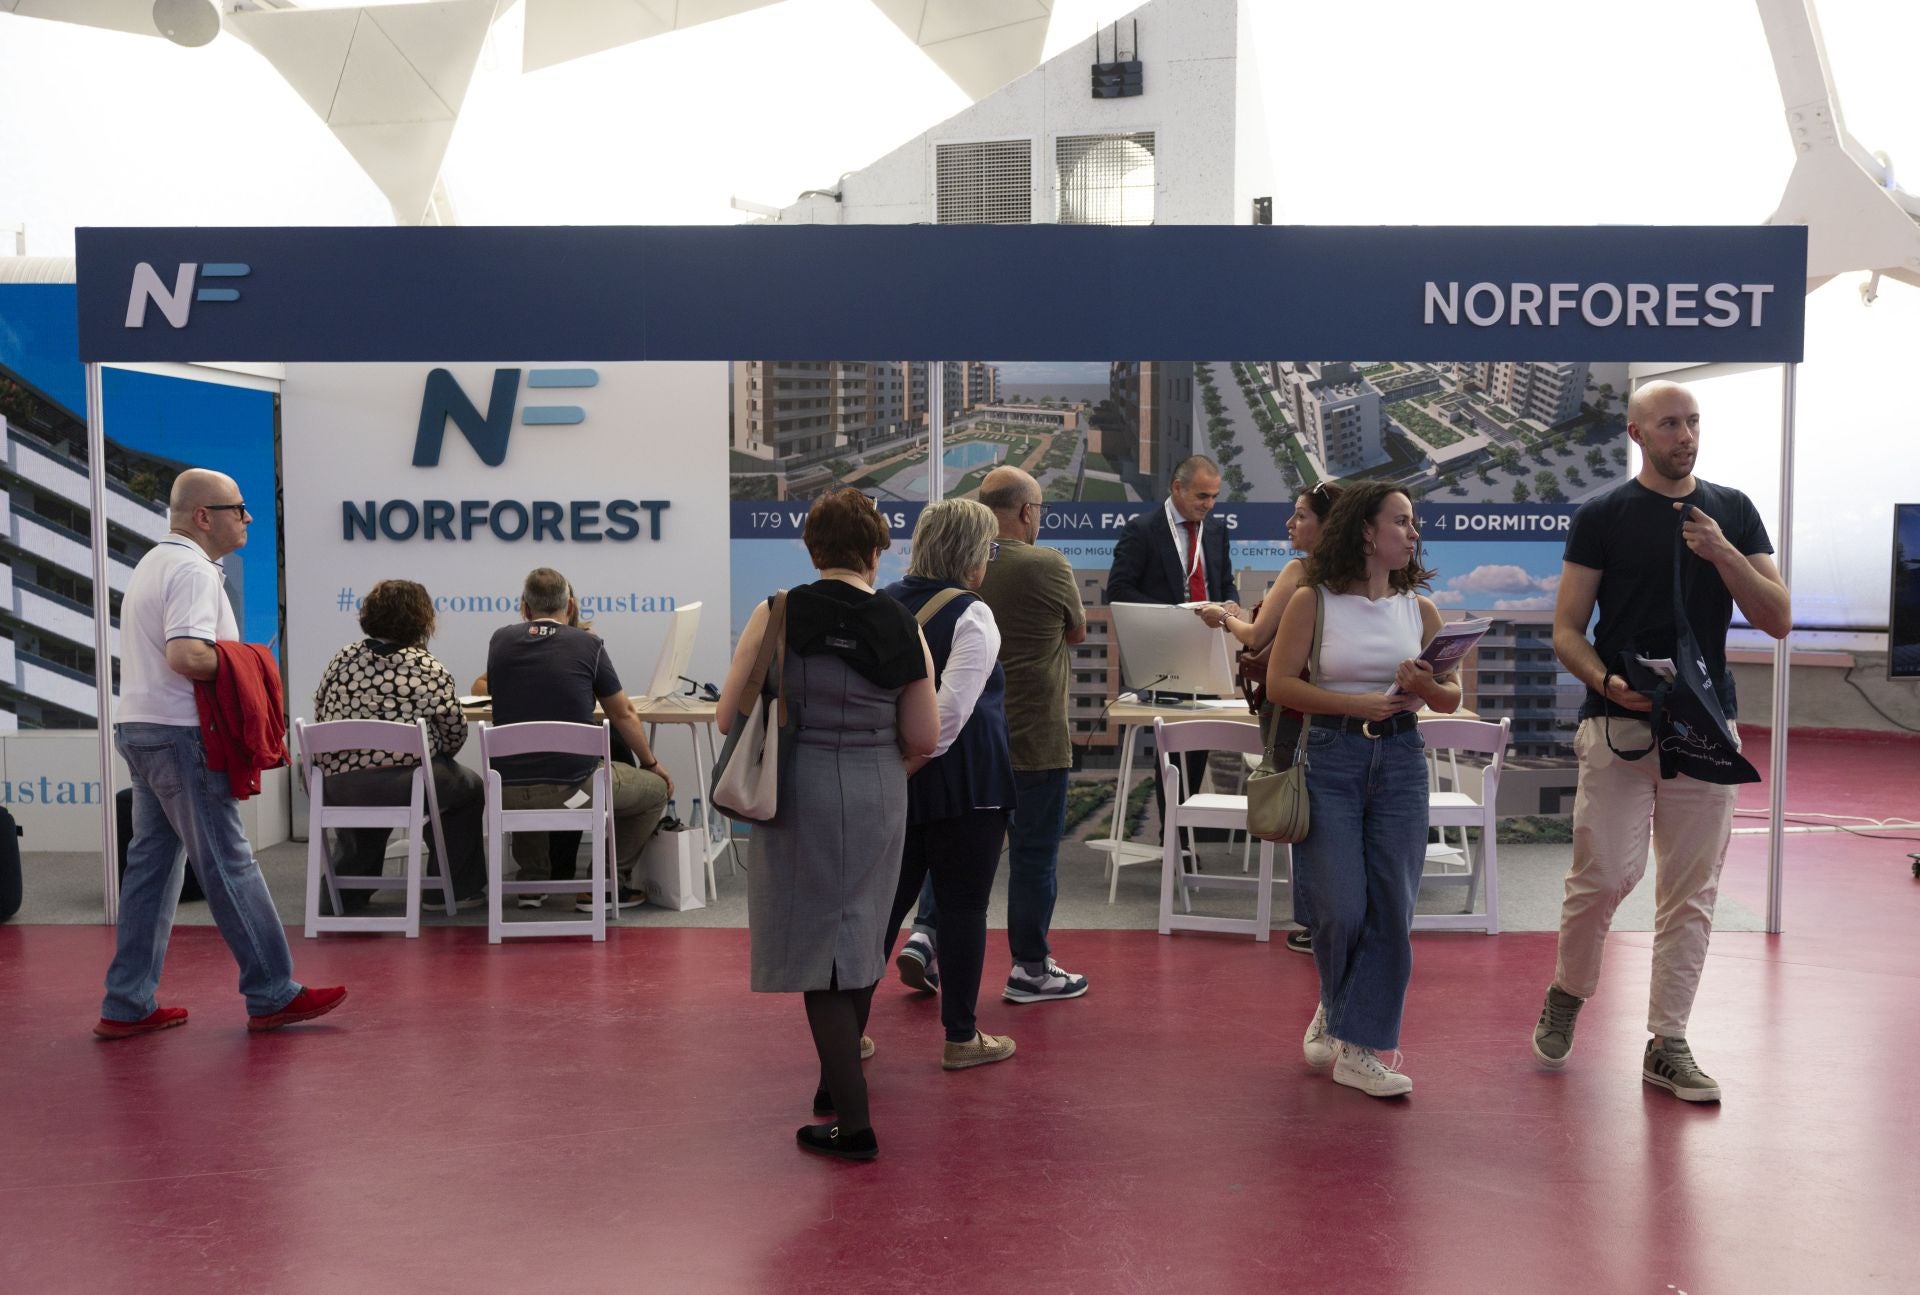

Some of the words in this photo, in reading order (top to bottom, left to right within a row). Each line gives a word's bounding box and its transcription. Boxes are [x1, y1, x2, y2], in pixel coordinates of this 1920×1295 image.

[125, 262, 250, 328] NF
[1424, 281, 1774, 327] NORFOREST
[412, 367, 600, 467] NF
[342, 499, 671, 542] NORFOREST
[751, 512, 782, 529] 179
[1434, 514, 1448, 530] 4
[1455, 514, 1572, 531] DORMITOR
[1085, 547, 1113, 556] MIGU
[1241, 547, 1286, 557] CENTRO
